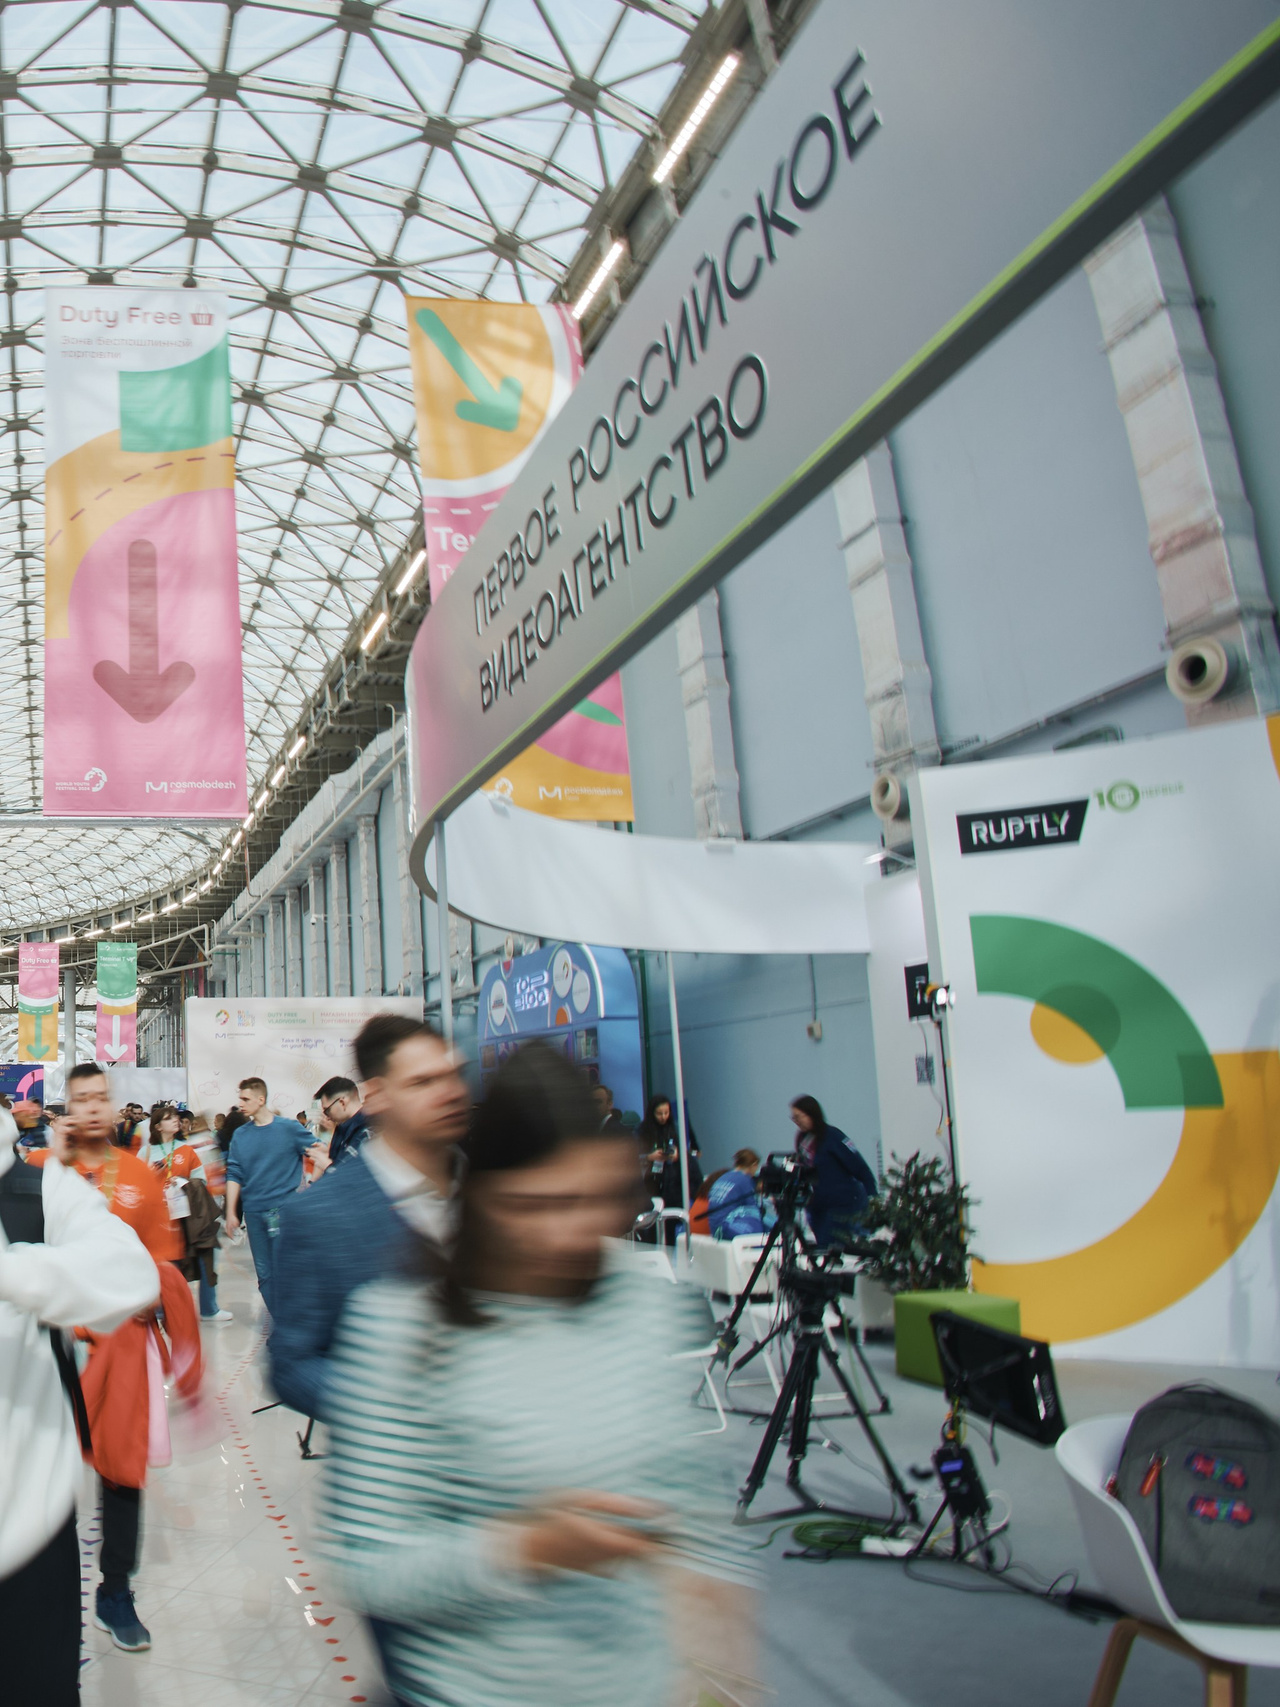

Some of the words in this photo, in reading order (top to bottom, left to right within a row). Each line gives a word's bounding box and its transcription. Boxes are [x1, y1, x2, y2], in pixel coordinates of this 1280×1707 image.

[59, 305, 119, 328] Duty
[126, 307, 182, 325] Free
[61, 335, 93, 346] Зона
[96, 336, 193, 348] беспошлинной
[472, 481, 562, 637] ПЕРВОЕ
[569, 45, 884, 514] РОССИЙСКОЕ
[478, 352, 768, 713] ВИДЕОАГЕНТСТВО
[170, 780, 236, 789] rosmolodezh
[970, 810, 1070, 845] RUPTLY
